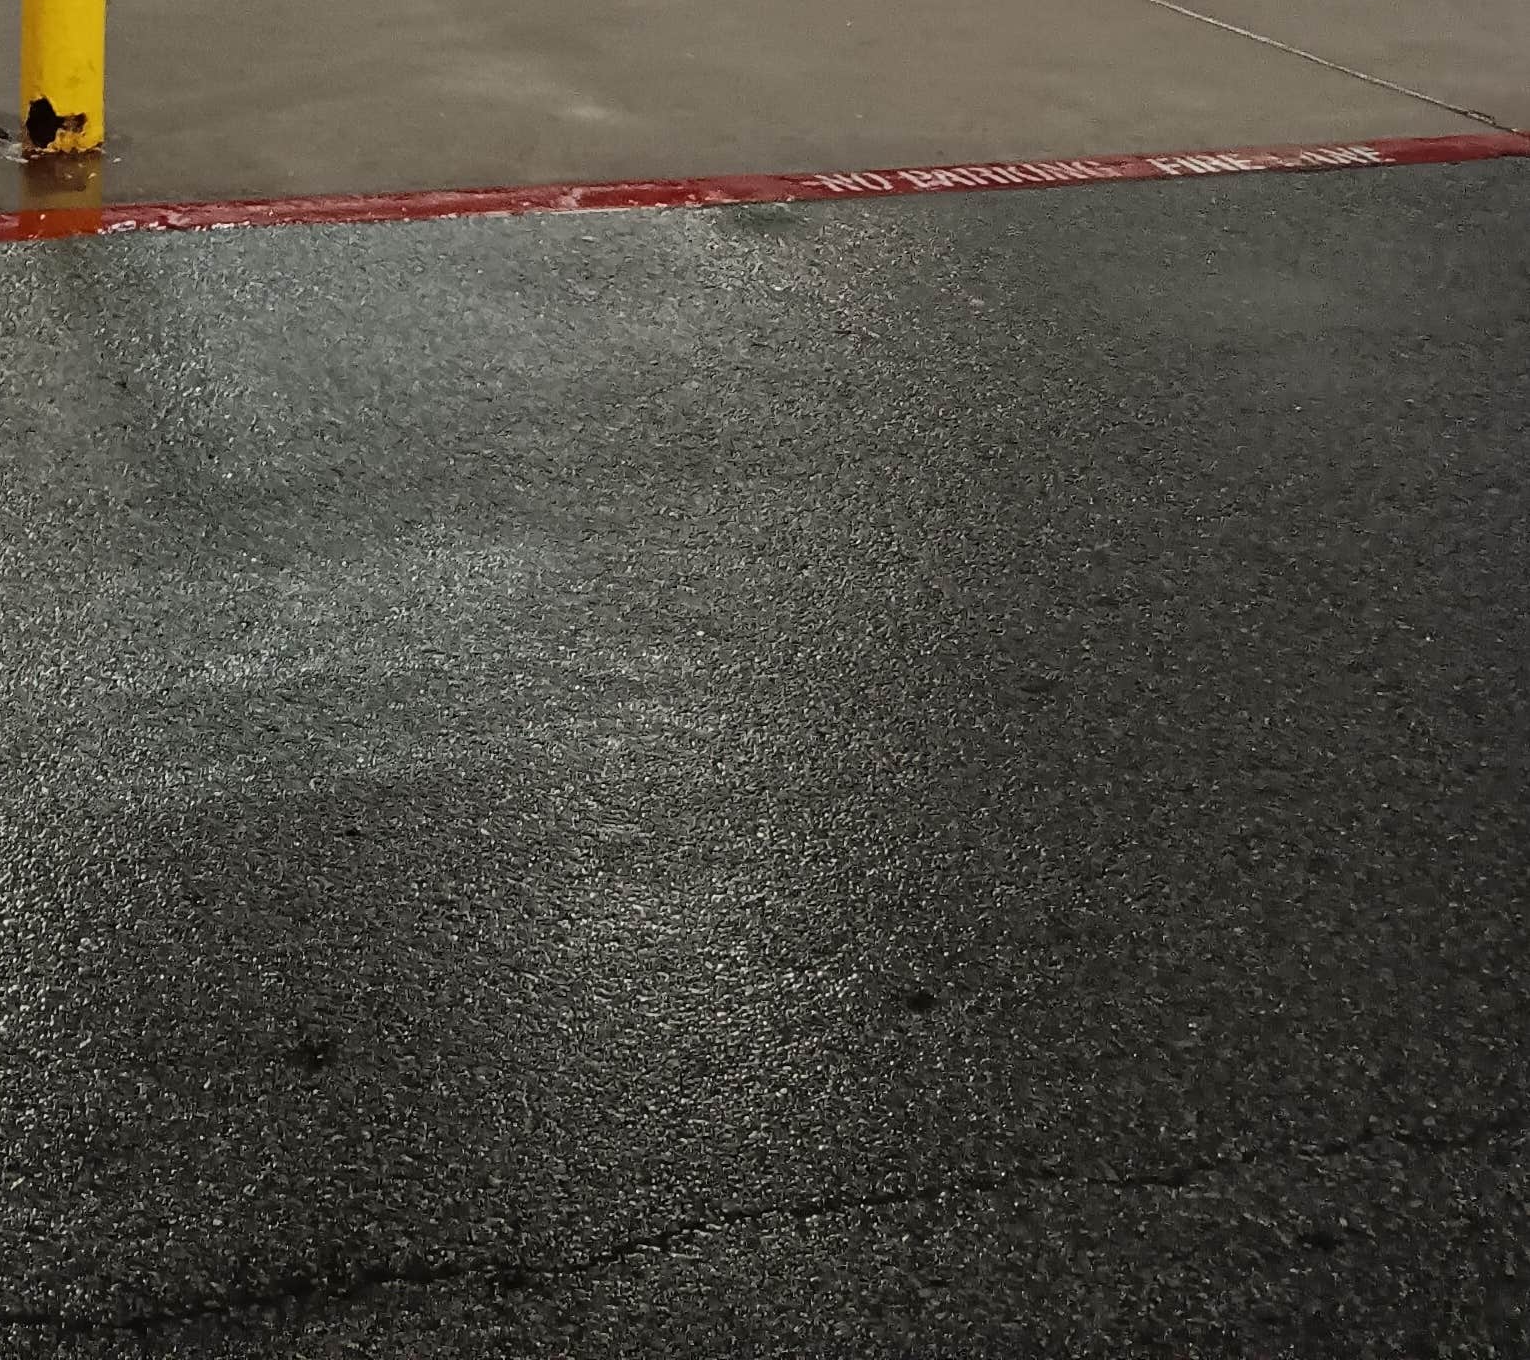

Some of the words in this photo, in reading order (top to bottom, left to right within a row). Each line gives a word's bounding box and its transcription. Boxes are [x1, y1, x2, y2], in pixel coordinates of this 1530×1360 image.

[804, 172, 893, 191] NO
[897, 160, 1122, 189] PARKING
[1146, 153, 1266, 176] FIRE
